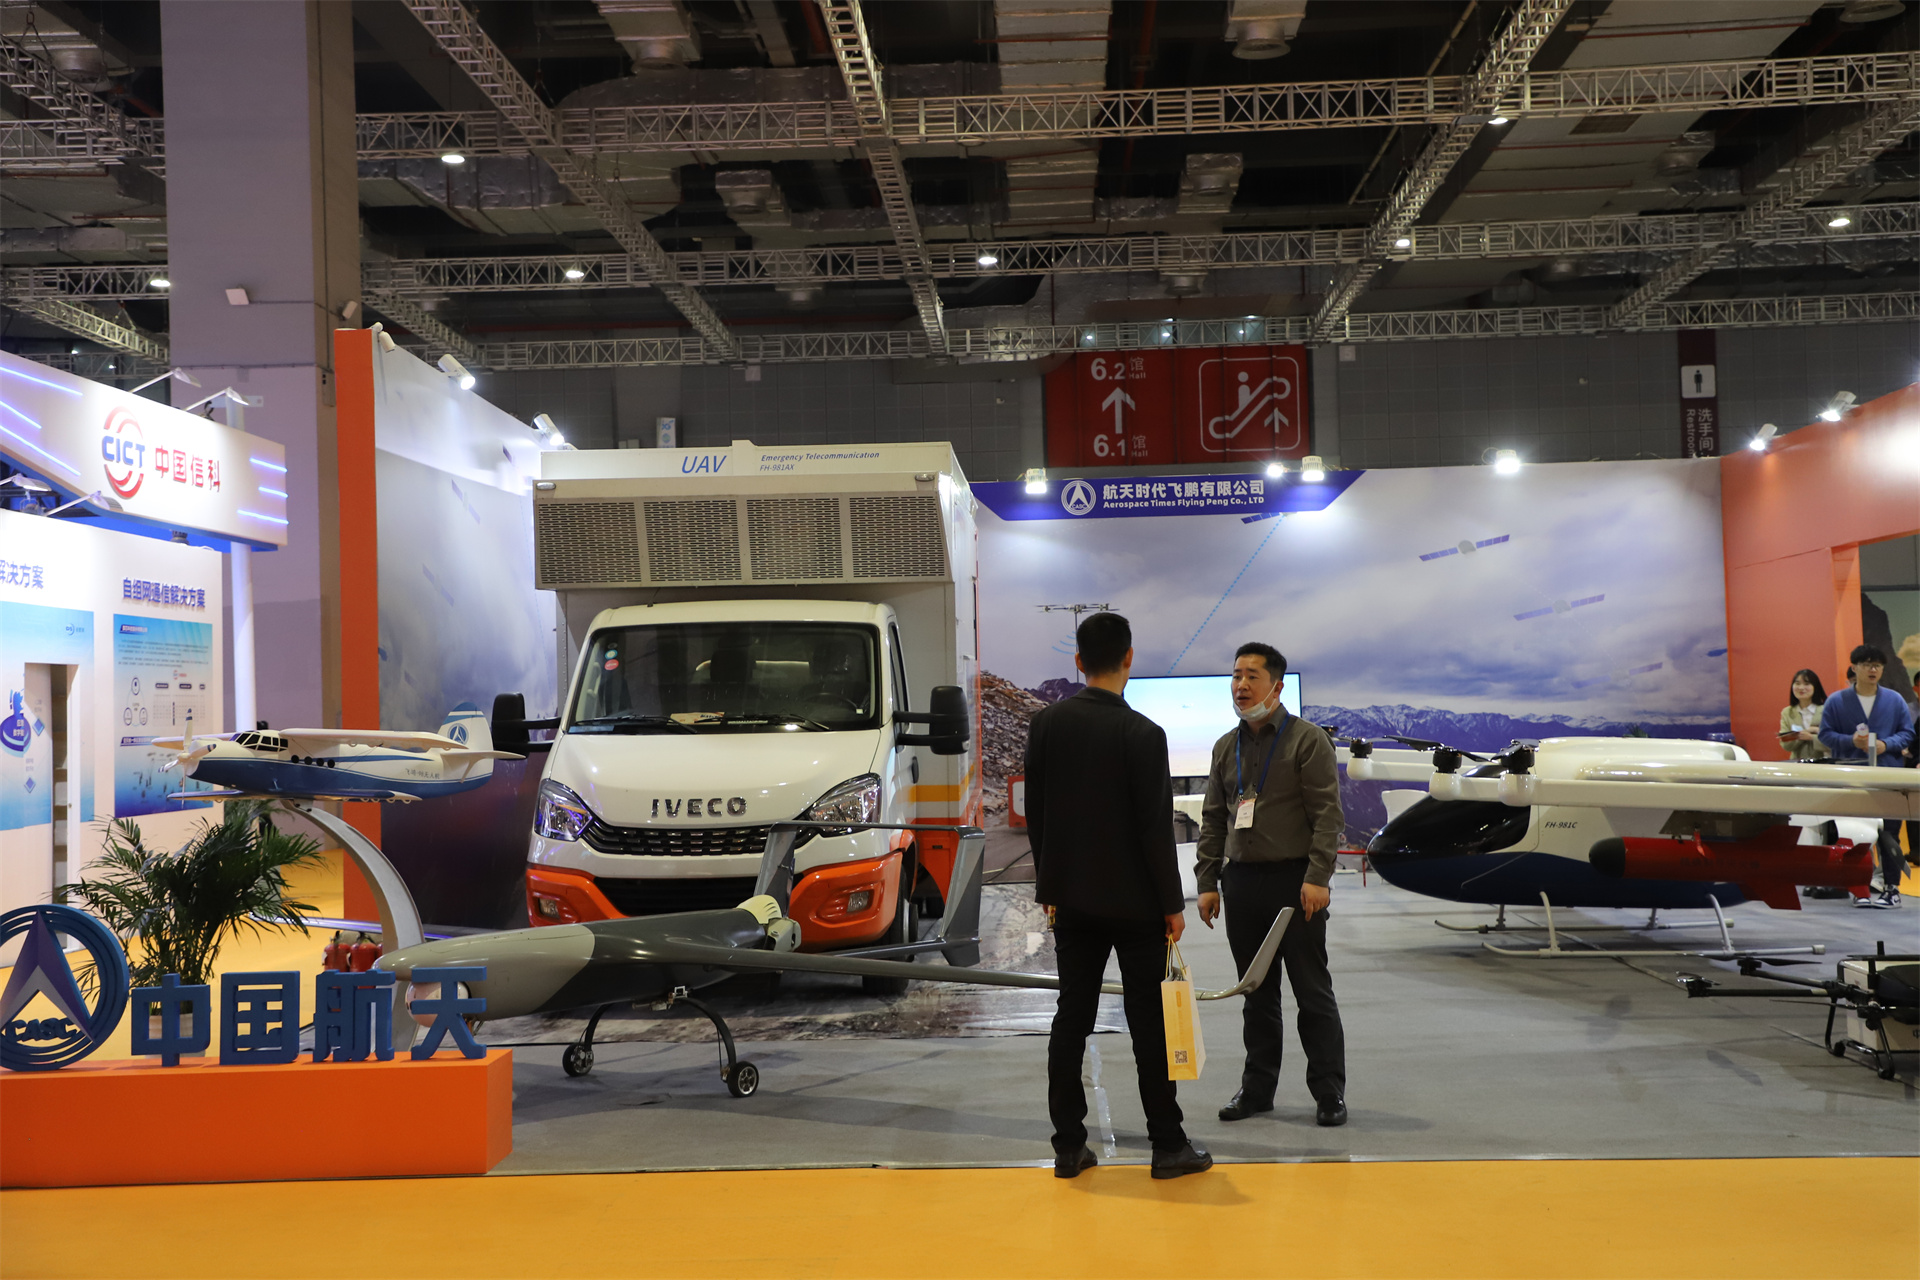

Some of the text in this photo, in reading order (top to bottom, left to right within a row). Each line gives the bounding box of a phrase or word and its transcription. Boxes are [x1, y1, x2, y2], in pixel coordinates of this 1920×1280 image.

[1091, 357, 1126, 381] 6.2
[1129, 357, 1144, 372] 馆
[1698, 407, 1714, 451] 洗手间
[102, 435, 146, 468] CICT
[1093, 434, 1126, 458] 6.1
[1132, 435, 1146, 450] 馆
[681, 455, 727, 473] UAV
[761, 451, 880, 463] Emergency Telecommunication
[1131, 450, 1148, 458] Hall
[155, 445, 221, 493] 中国信科
[759, 464, 795, 472] FH-981AX
[1102, 479, 1264, 500] 航天时代飞鹏有限公司
[1103, 496, 1265, 509] Aerospace Times Flying Peng Co., LTD
[123, 577, 206, 608] 自组网通信解决方案
[652, 797, 747, 817] IVECO
[1544, 821, 1578, 829] FH-981C
[131, 966, 488, 1067] 中国航天
[5, 1018, 77, 1042] CASC
